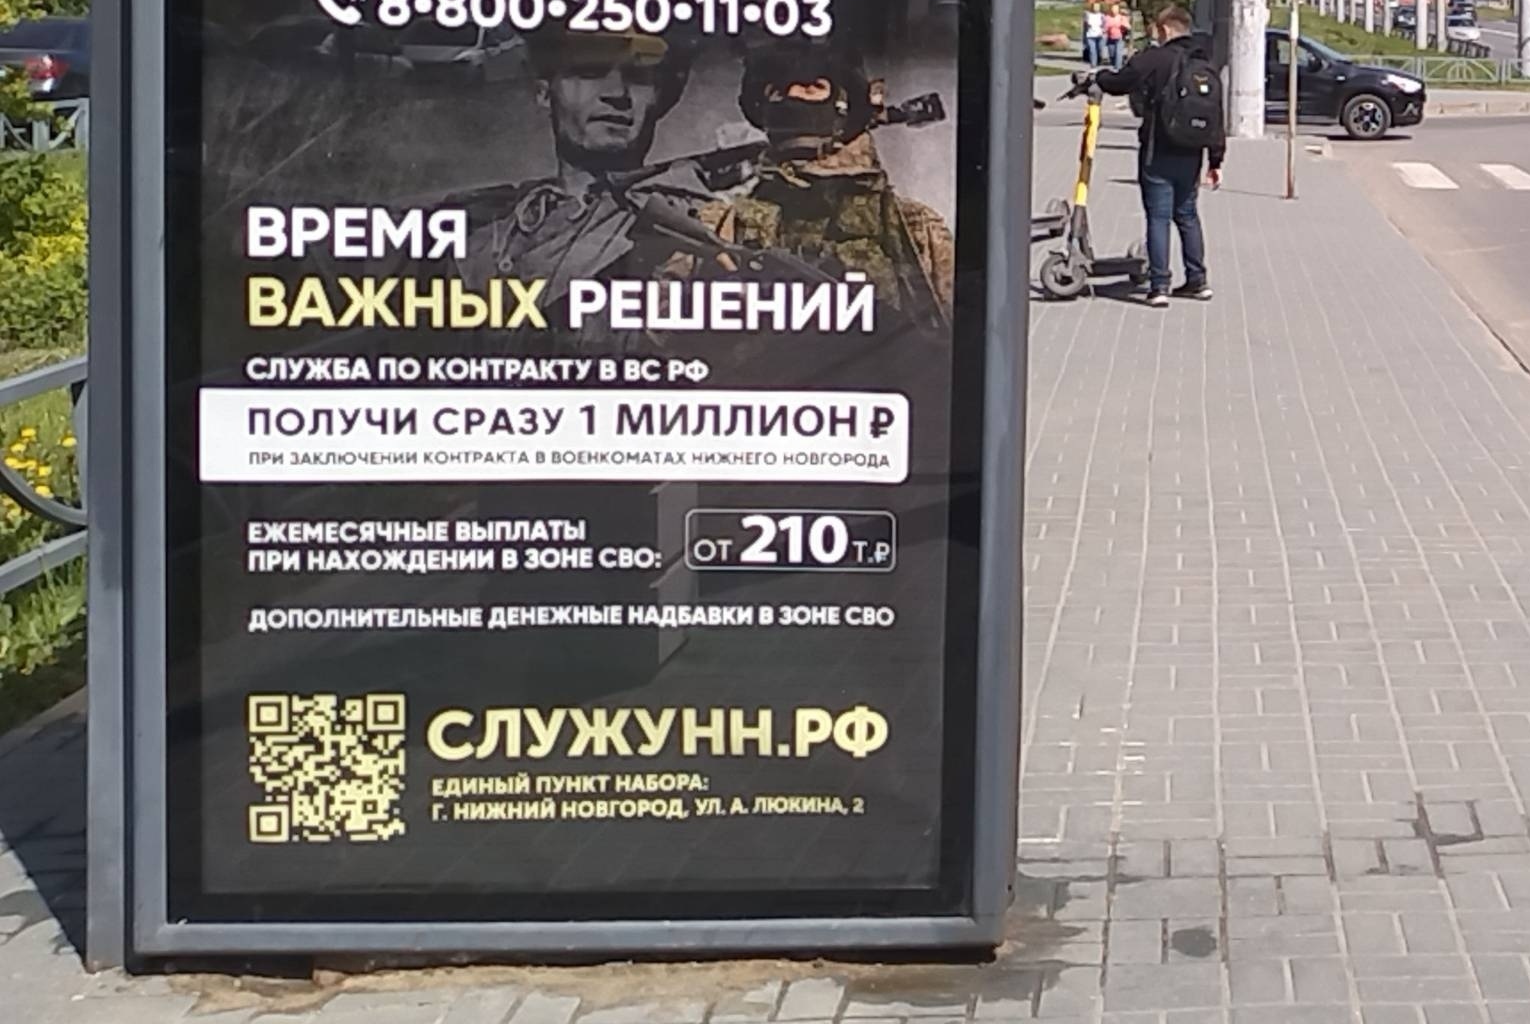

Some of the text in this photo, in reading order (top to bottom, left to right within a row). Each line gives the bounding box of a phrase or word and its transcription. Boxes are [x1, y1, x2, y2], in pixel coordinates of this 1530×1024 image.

[249, 207, 466, 258] ВРЕМЯ
[249, 272, 874, 331] ВАЖНЫХ РЕШЕНИЙ
[247, 358, 708, 381] СЛУЖБА ПО КОНТРАКТУ В ВС РФ
[249, 408, 417, 436] ПОЛУЧИ
[433, 408, 563, 435] СРАЗУ
[580, 405, 595, 435] 1
[616, 404, 857, 437] МИЛЛИОН
[249, 451, 889, 469] ПРИ ЗАКЛЮЧЕНИИ КОНТРАКТА В ВОЕНКОМАТАХ НИЖНЕГО НОВГОРОДА
[249, 520, 585, 543] ЕЖЕМЕСЯЧНЫЕ ВЫПЛАТЫ
[694, 539, 732, 561] ОТ
[741, 515, 848, 563] 210
[249, 548, 661, 573] ПРИ НАХОЖДЕНИИ В ЗОНЕ СВО:
[248, 605, 894, 632] ДОПОЛНИТЕЛЬНЫЕ ДЕНЕЖНЫЕ НАДБАВКИ В ЗОНЕ СВО
[428, 706, 887, 760] СЛУЖУНН.РФ
[433, 773, 708, 798] ЕДИНЫЙ ПУНКТ НАБОРА:
[433, 797, 864, 820] Г. НИЖНИЙ НОВГОРОД, УЛ. А. ЛЮКИНА, 2
